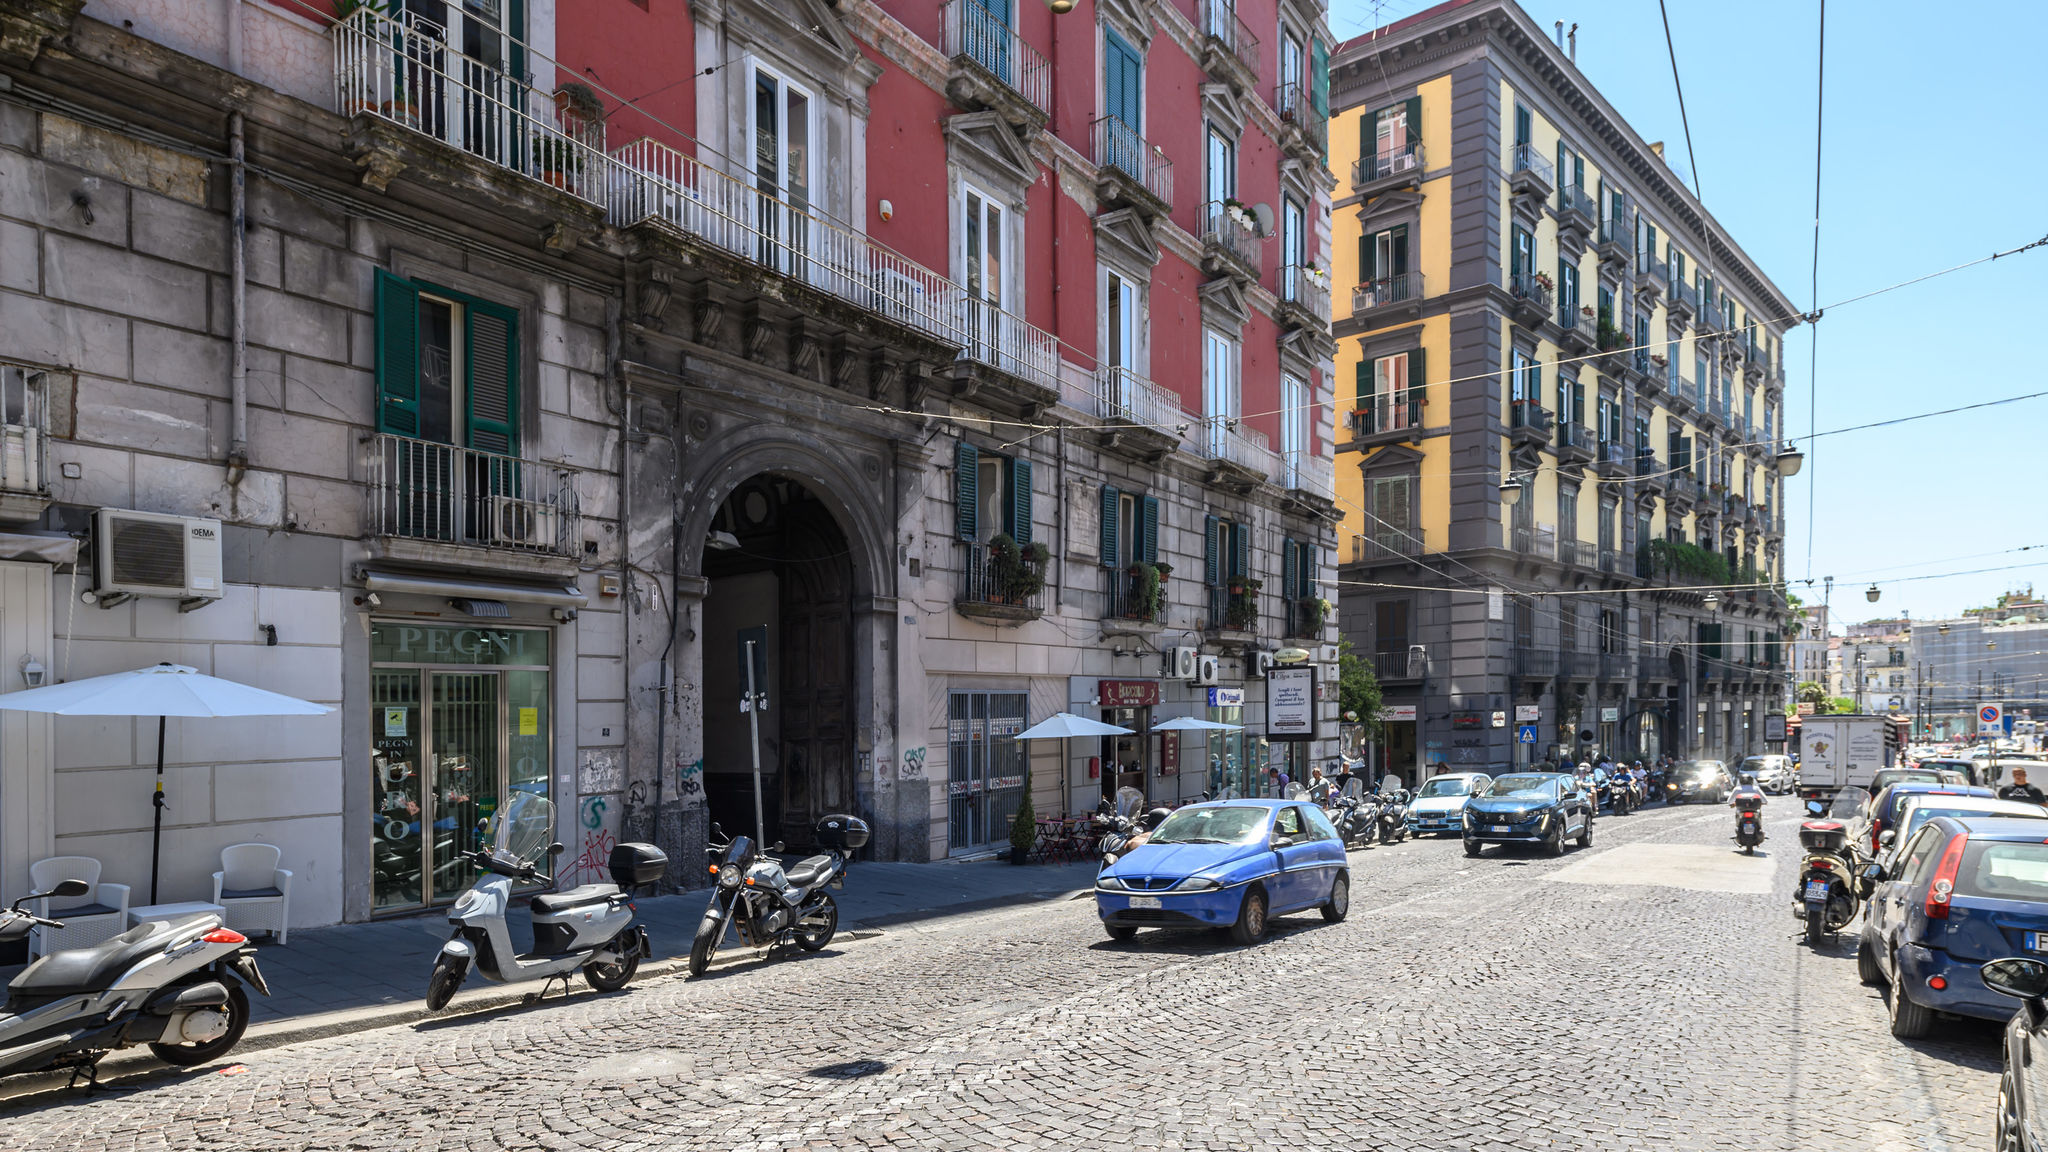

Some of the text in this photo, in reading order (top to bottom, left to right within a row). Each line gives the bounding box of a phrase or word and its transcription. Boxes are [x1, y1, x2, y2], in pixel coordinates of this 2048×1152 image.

[398, 626, 526, 657] PEGNI
[378, 739, 414, 749] PEGNI
[389, 750, 403, 759] IN
